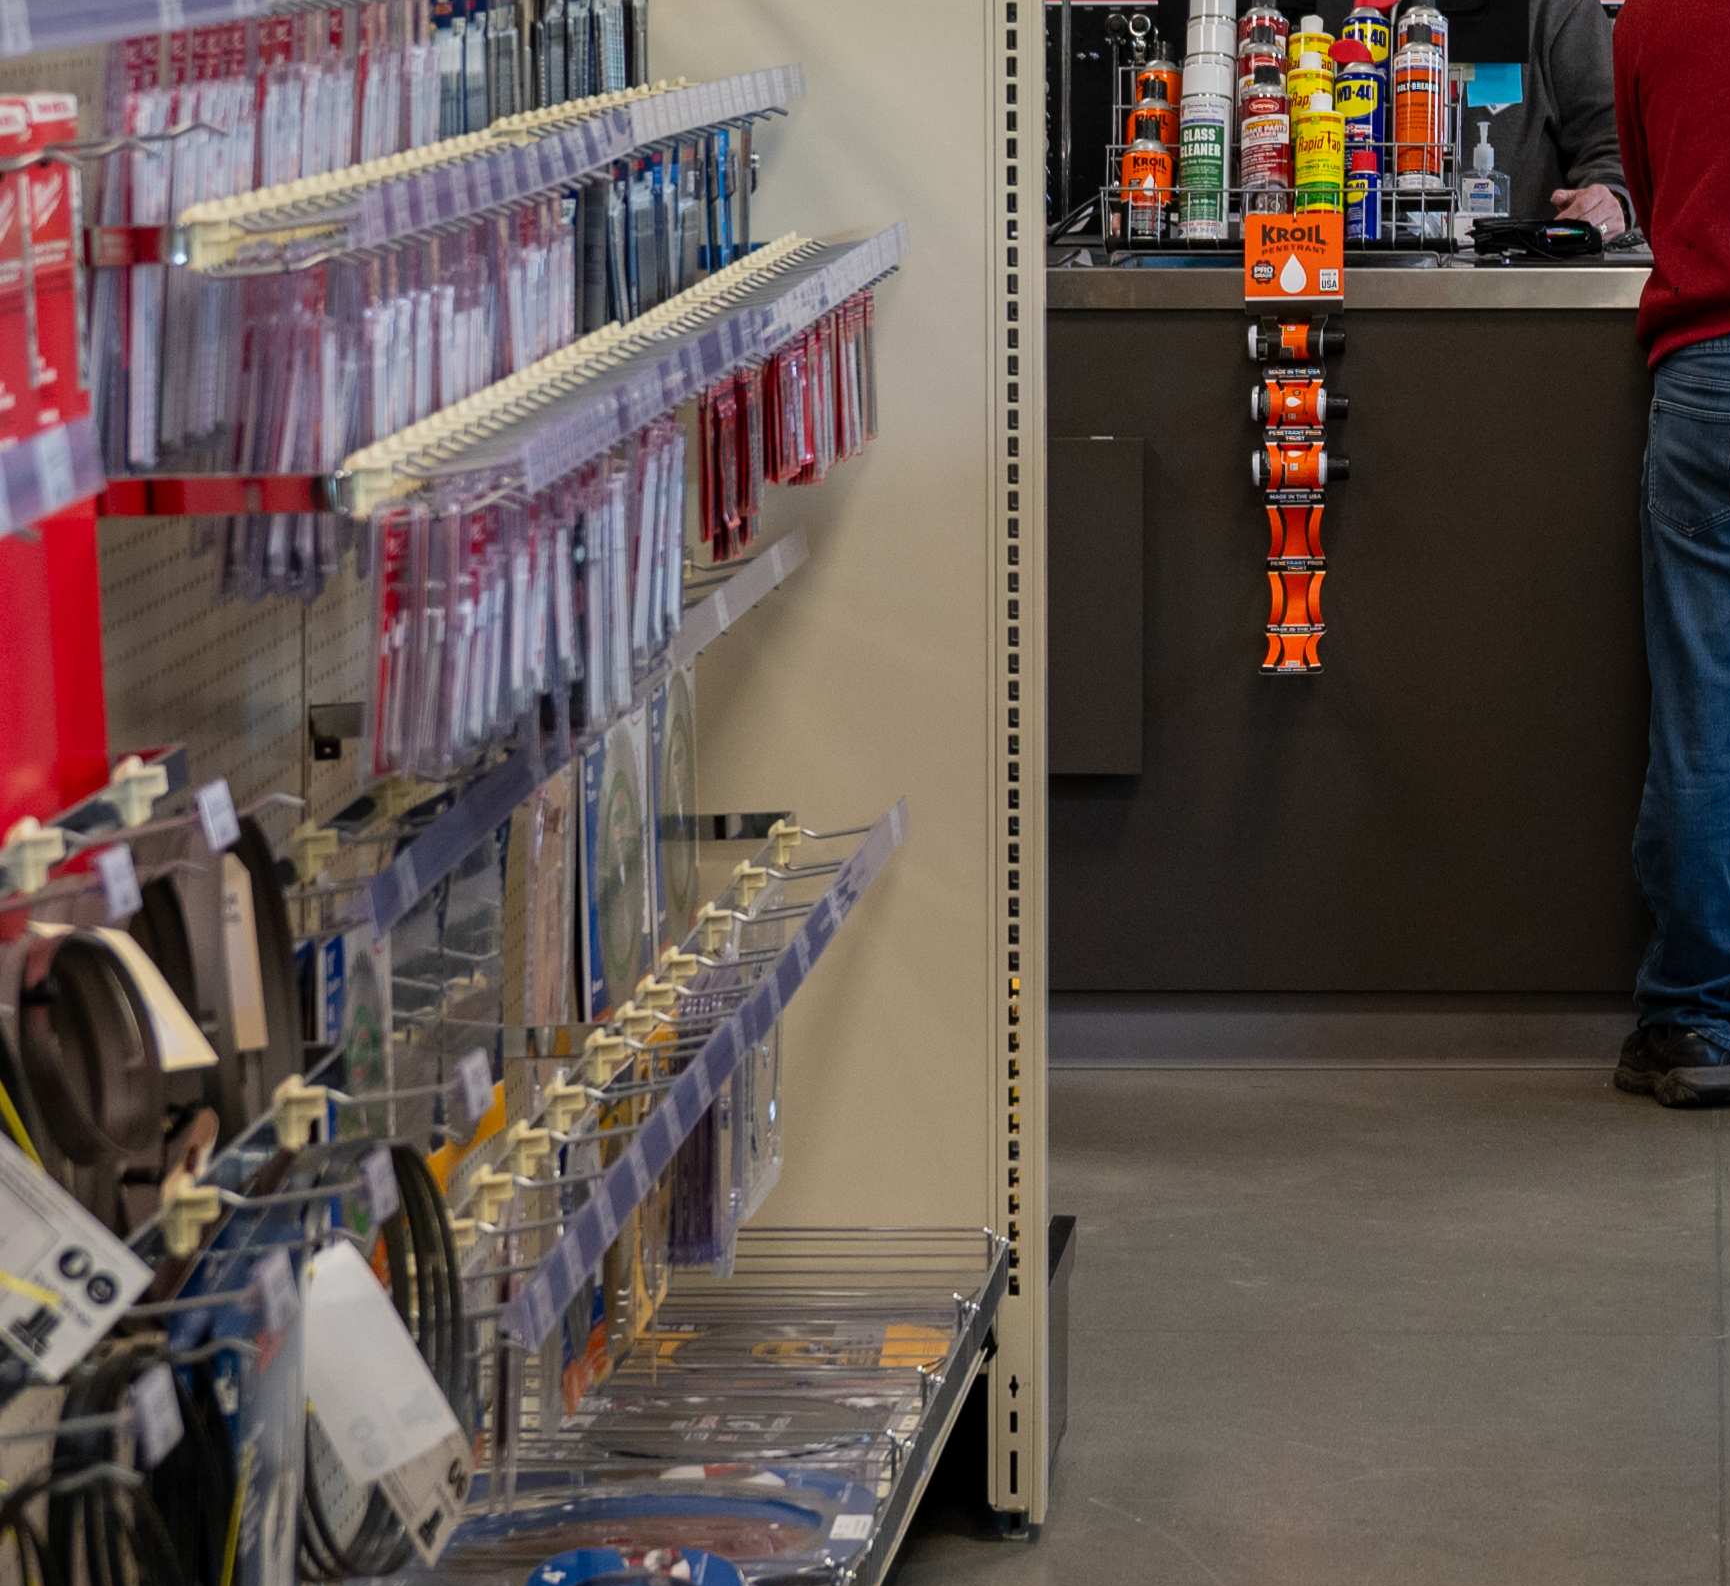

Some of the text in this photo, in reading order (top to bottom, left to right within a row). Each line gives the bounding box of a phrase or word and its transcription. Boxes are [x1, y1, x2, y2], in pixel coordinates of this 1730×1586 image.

[1337, 84, 1375, 105] WD-40
[1183, 128, 1216, 143] GLASS
[1180, 143, 1221, 158] CLEANER
[1298, 135, 1324, 153] Rapid
[1133, 156, 1167, 171] KROIL
[1262, 224, 1326, 246] KROIL
[1262, 244, 1326, 256] PENETRANT
[1322, 280, 1337, 288] USA
